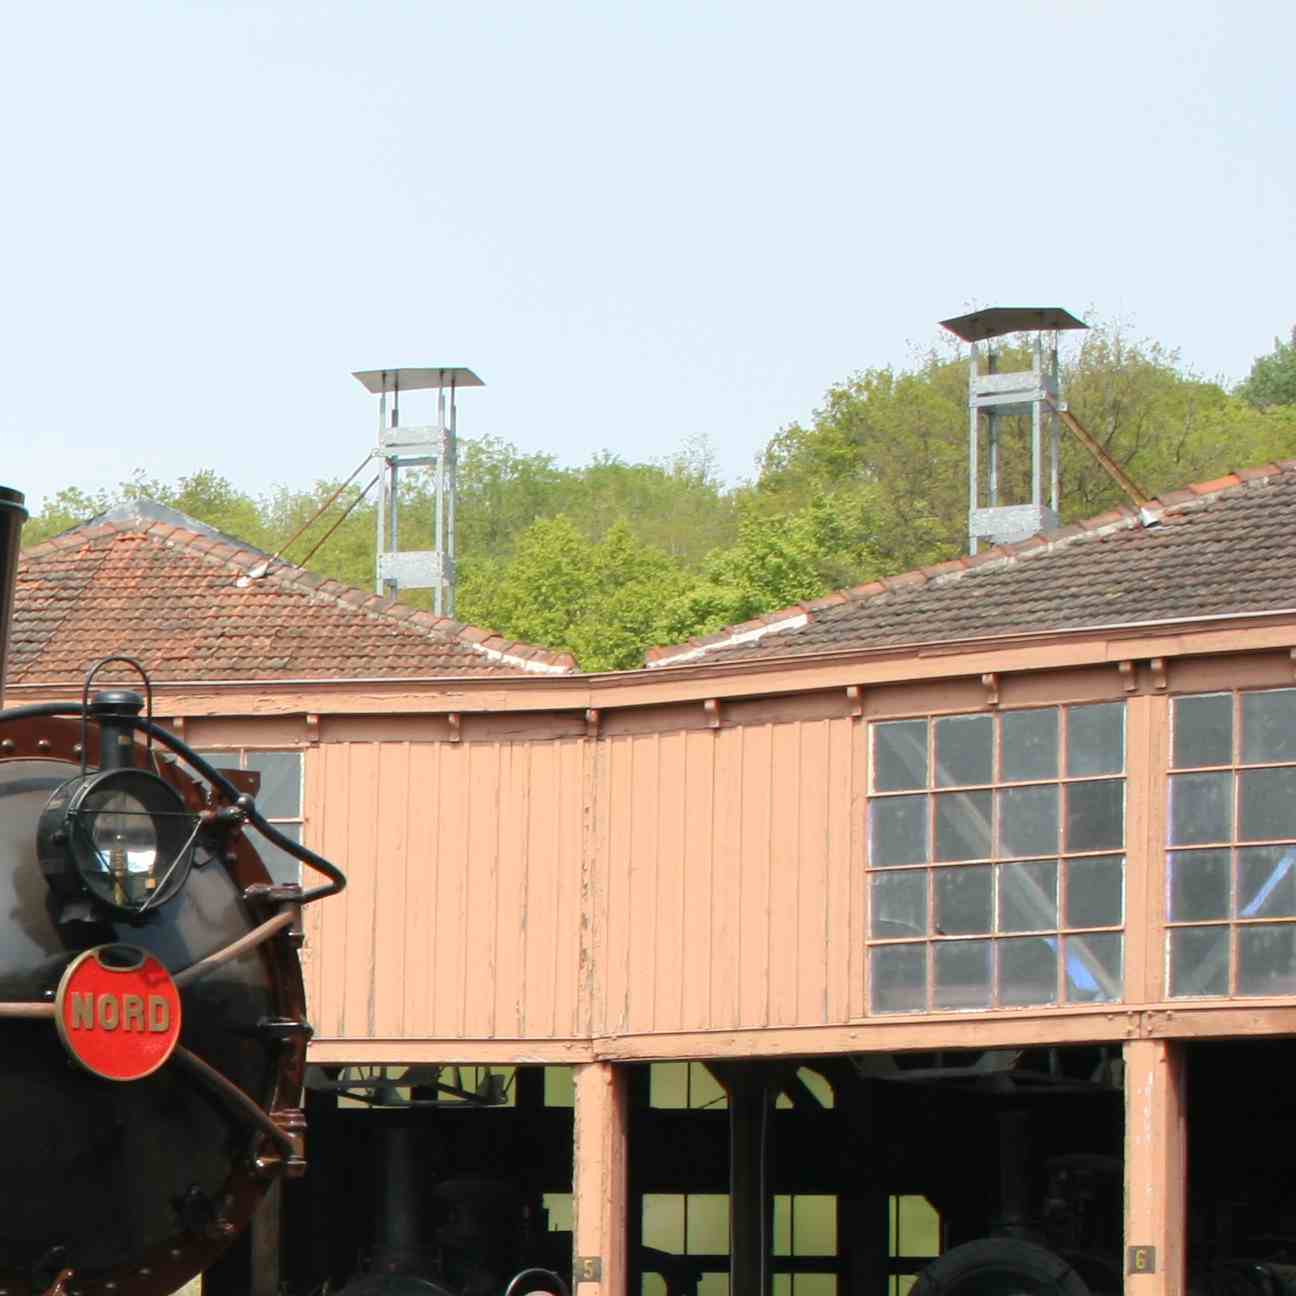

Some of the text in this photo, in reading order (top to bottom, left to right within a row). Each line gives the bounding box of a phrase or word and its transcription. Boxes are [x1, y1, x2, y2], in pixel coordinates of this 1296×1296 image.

[71, 992, 171, 1034] NORD
[583, 1259, 593, 1279] 5
[1135, 1249, 1147, 1270] 6
